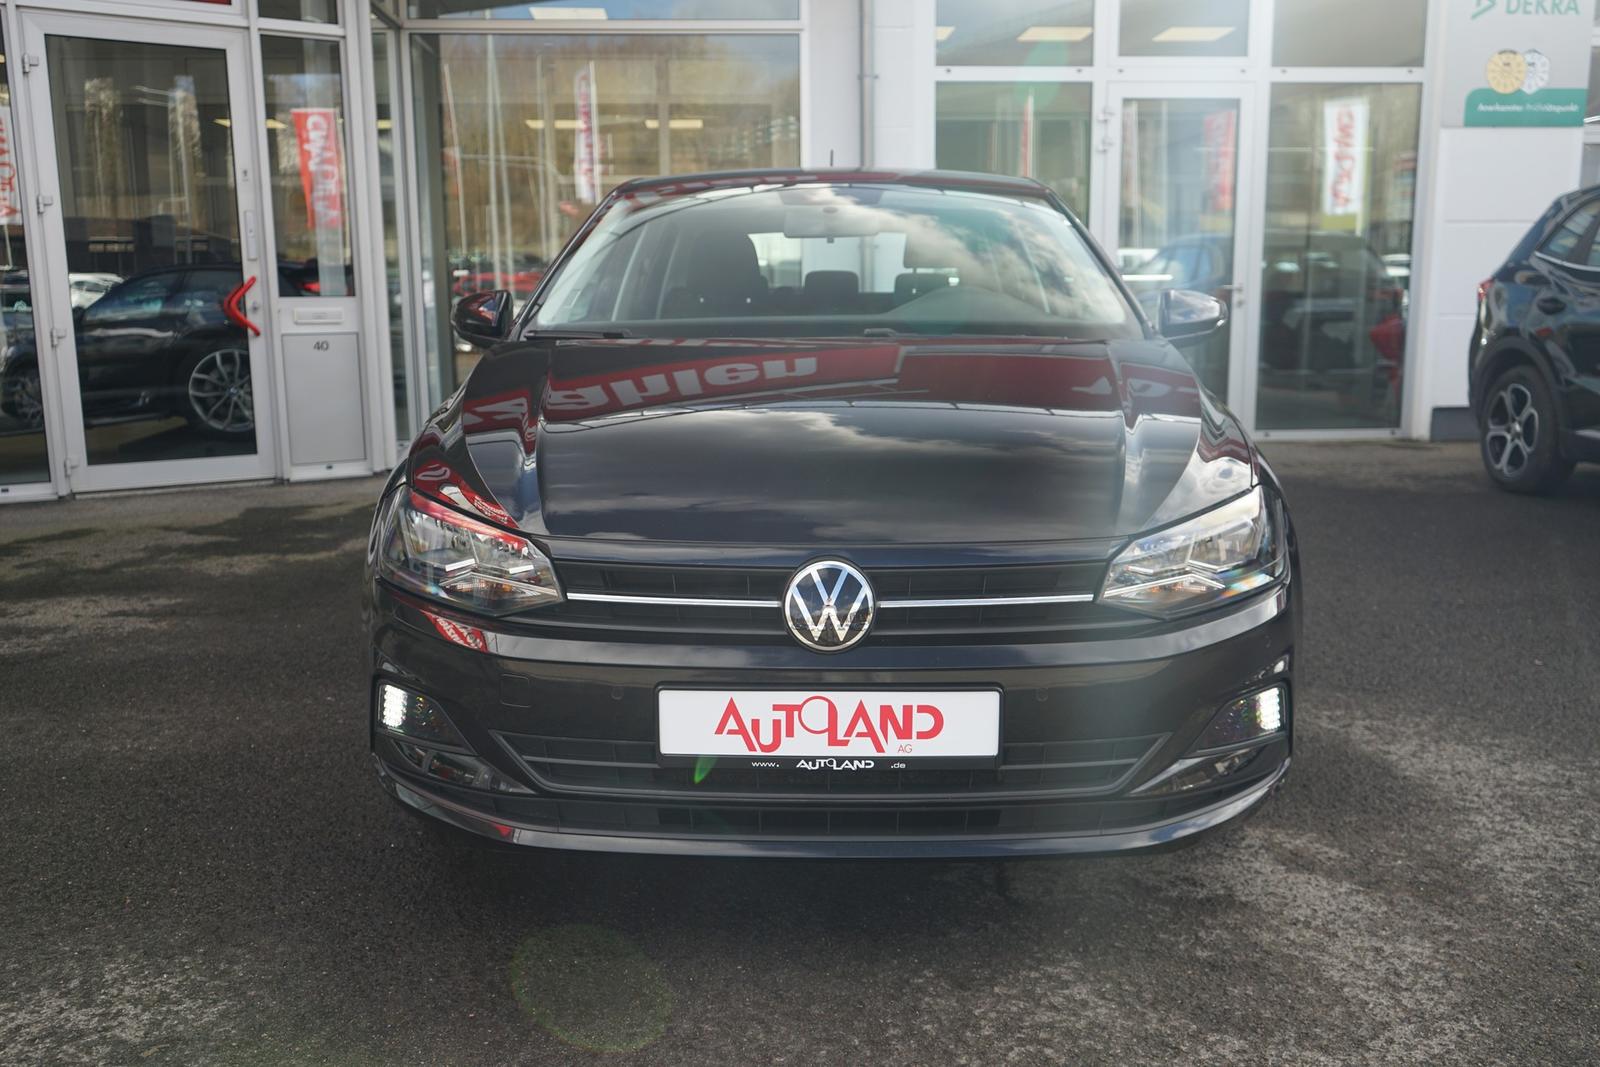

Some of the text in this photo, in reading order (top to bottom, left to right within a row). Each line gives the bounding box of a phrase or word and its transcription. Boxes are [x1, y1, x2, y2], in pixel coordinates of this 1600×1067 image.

[1505, 0, 1580, 15] DEKRA
[313, 340, 329, 352] 40
[787, 563, 871, 646] VW
[714, 695, 945, 753] AUTOLAND
[897, 744, 913, 753] AG
[796, 758, 875, 771] AUTOLAND
[890, 761, 906, 769] .de
